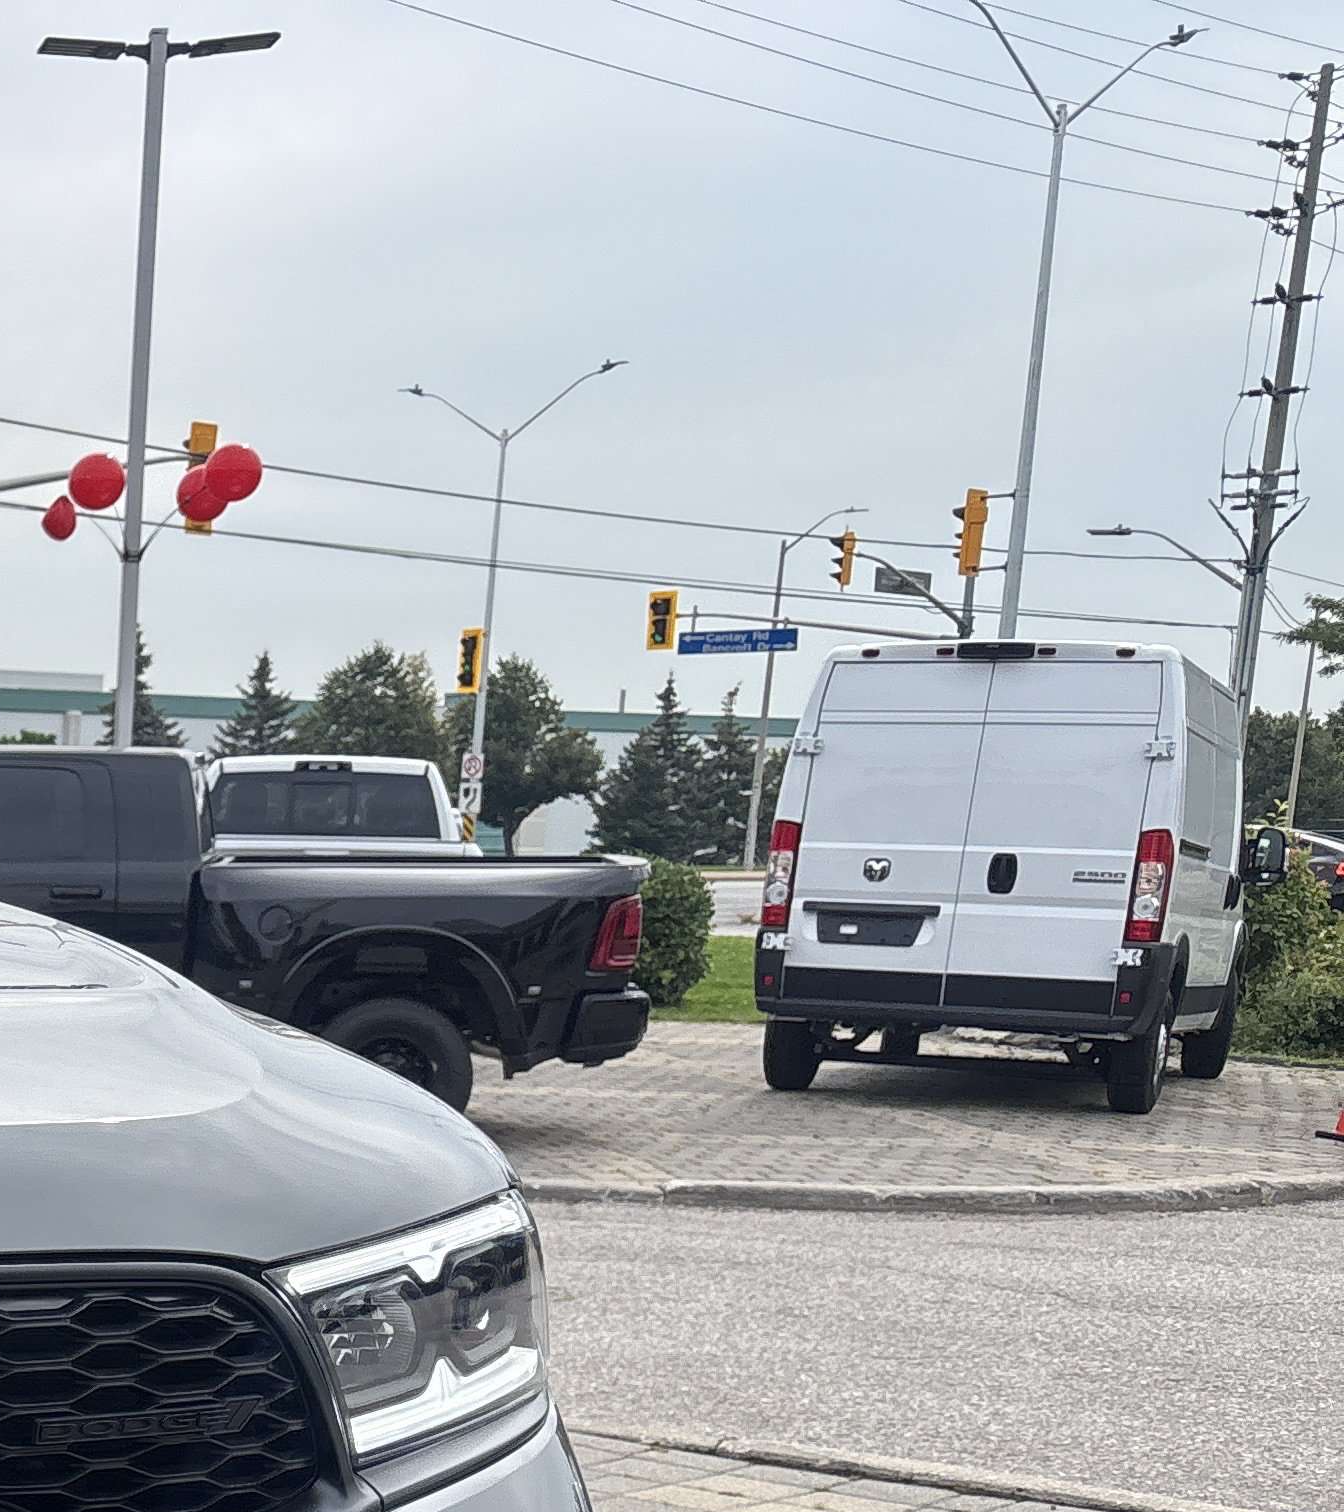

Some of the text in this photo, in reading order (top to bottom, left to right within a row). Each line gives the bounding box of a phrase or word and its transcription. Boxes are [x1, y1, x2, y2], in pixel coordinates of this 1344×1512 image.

[753, 631, 770, 641] Rd
[702, 641, 770, 653] Bancroft Dr
[1073, 871, 1126, 879] 2500
[38, 1407, 231, 1441] DODGE
